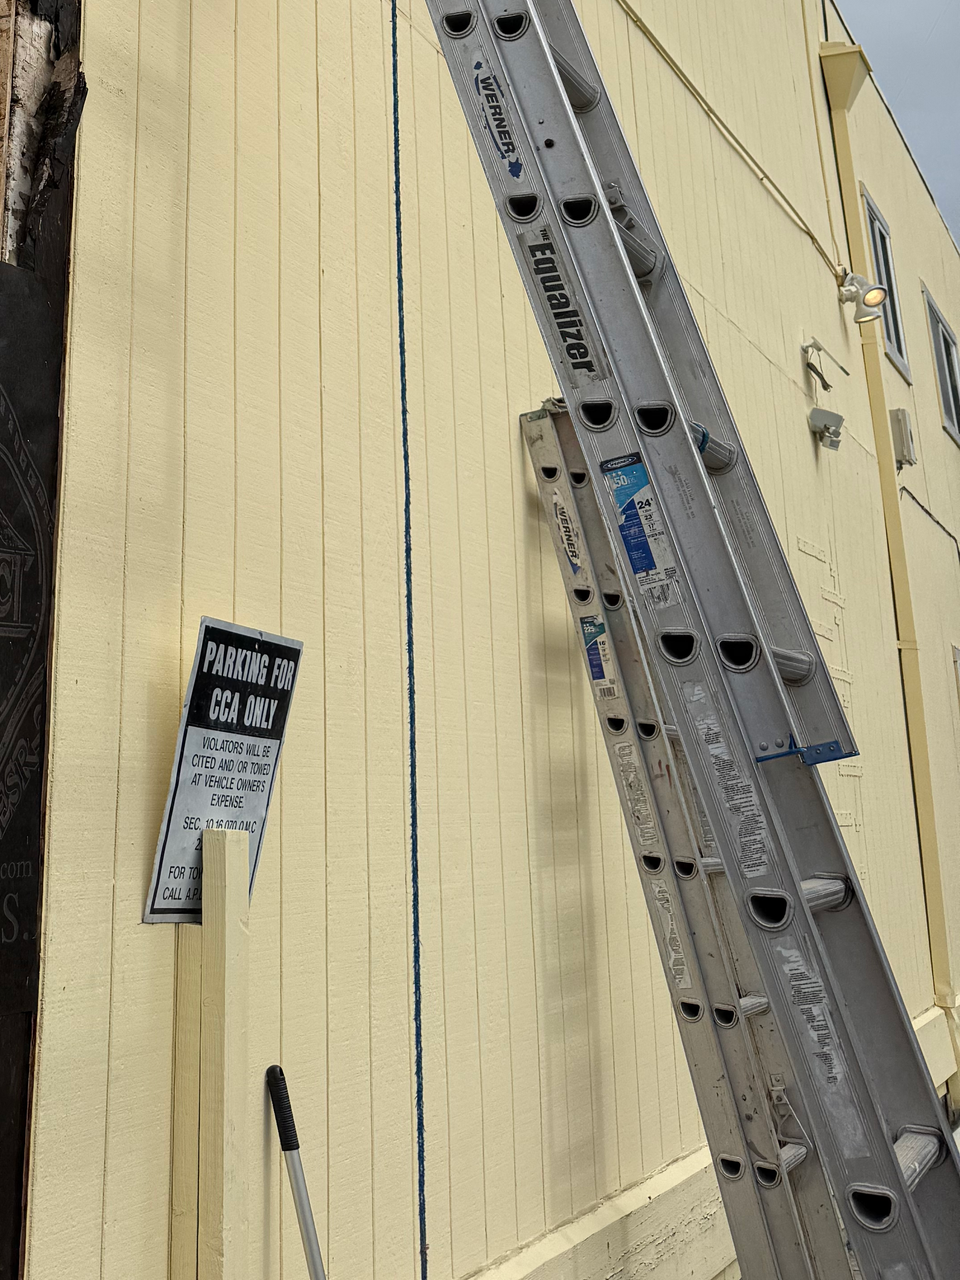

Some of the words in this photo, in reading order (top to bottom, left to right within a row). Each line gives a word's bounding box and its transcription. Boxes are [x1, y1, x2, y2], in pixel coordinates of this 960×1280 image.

[478, 75, 516, 155] WERNER
[539, 228, 550, 242] THE
[527, 242, 597, 373] Equalizer
[558, 506, 578, 559] WERNER
[202, 640, 270, 686] PARKING
[270, 657, 296, 691] FOR
[208, 687, 241, 725] CCA
[244, 694, 279, 730] ONLY
[202, 736, 245, 755] VIOLATORS
[245, 743, 261, 757] WILL
[262, 745, 272, 758] BE
[191, 753, 217, 770] CITED
[218, 758, 249, 774] AND/OR
[249, 762, 271, 776] TOWED
[190, 772, 203, 786] AT
[204, 774, 236, 790] VEHICLE
[182, 816, 201, 831] SEC.
[167, 865, 186, 880] FOR
[162, 886, 182, 901] CALL
